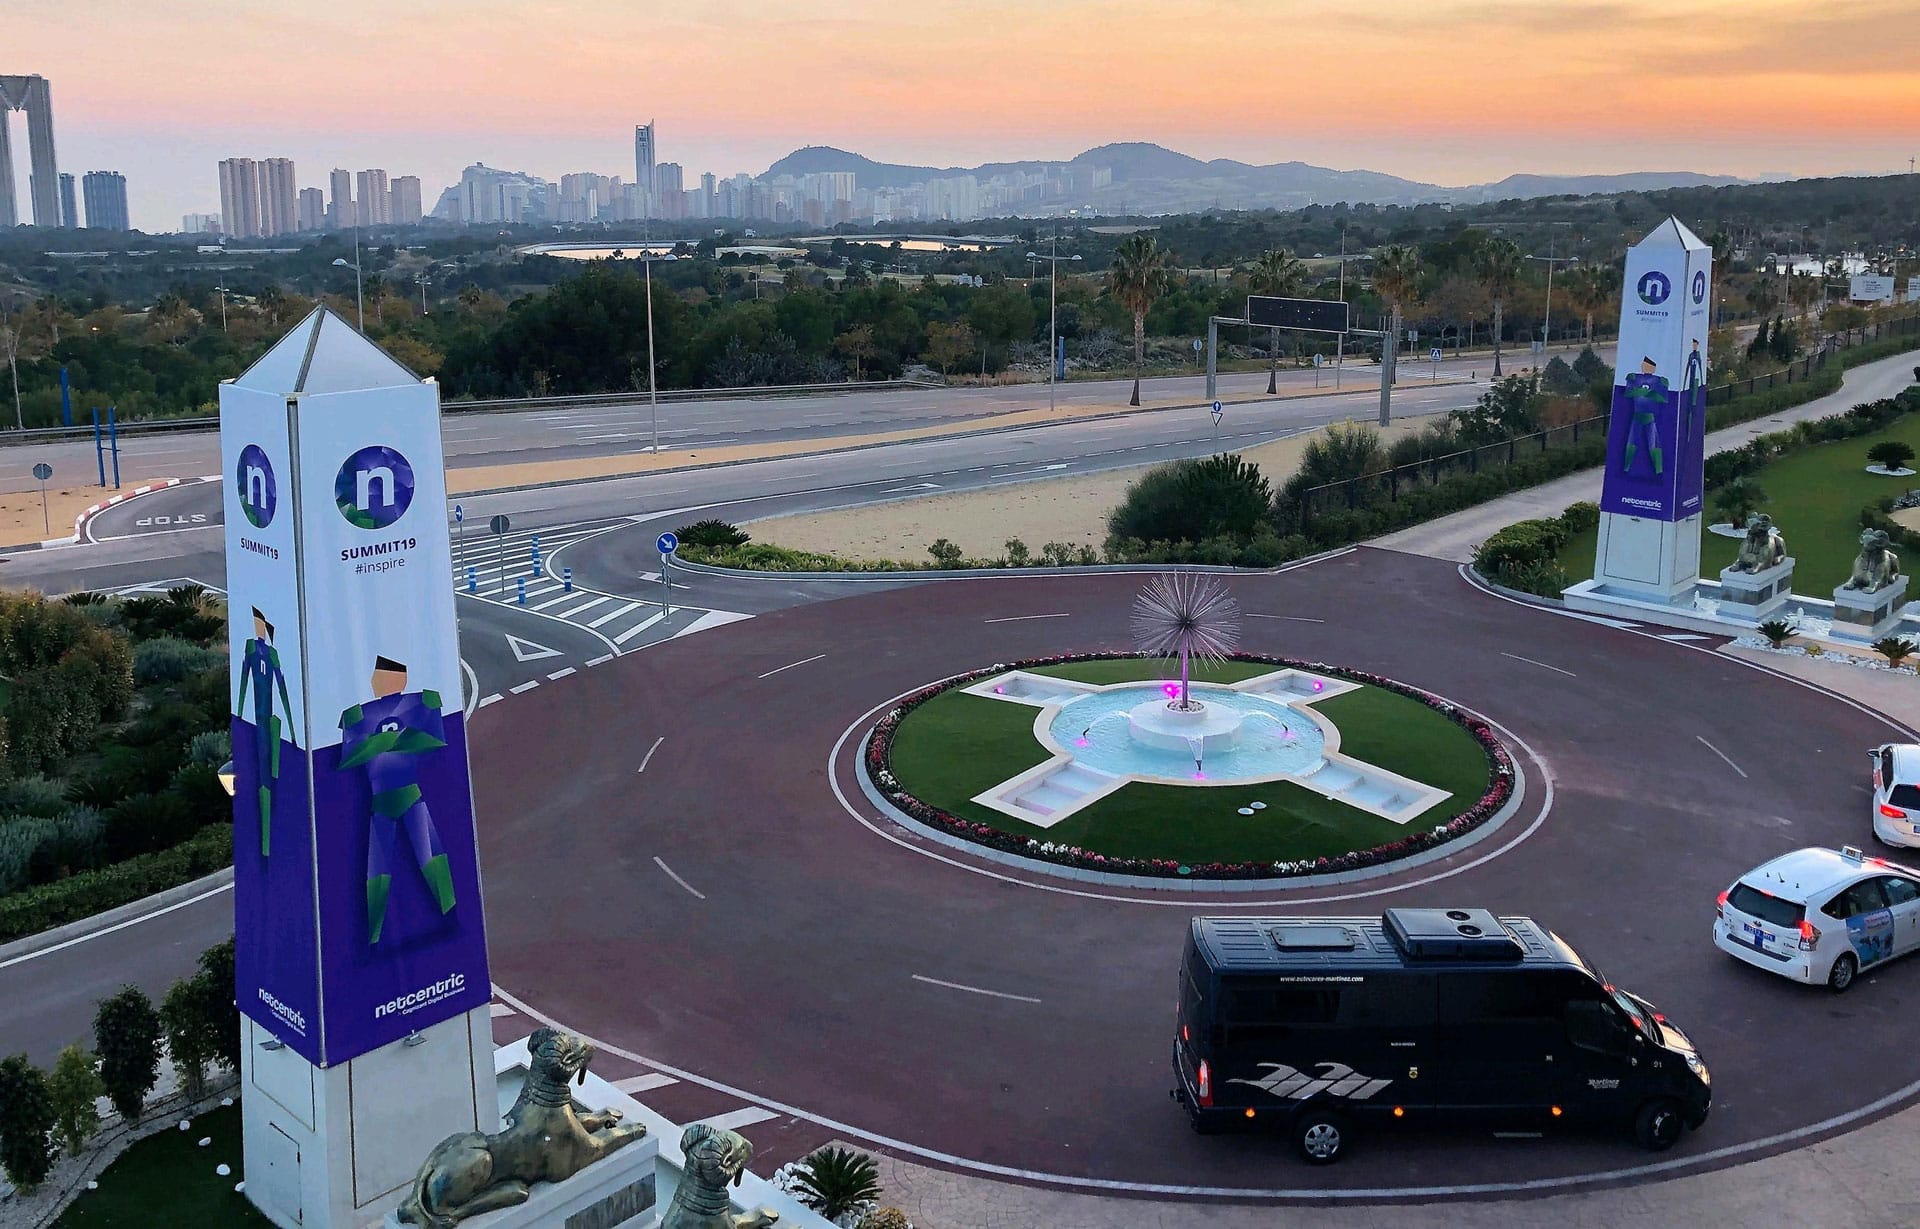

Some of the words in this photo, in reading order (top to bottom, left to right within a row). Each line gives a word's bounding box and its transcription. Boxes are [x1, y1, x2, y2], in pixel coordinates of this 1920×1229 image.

[1645, 280, 1663, 297] n
[246, 465, 268, 509] n
[356, 466, 396, 511] n
[135, 514, 207, 526] STOP
[240, 537, 279, 560] SUMMIT19
[341, 537, 416, 561] SUMMIT19
[355, 557, 405, 575] #inspire
[375, 973, 465, 1018] netcentric
[259, 988, 306, 1029] netcentric
